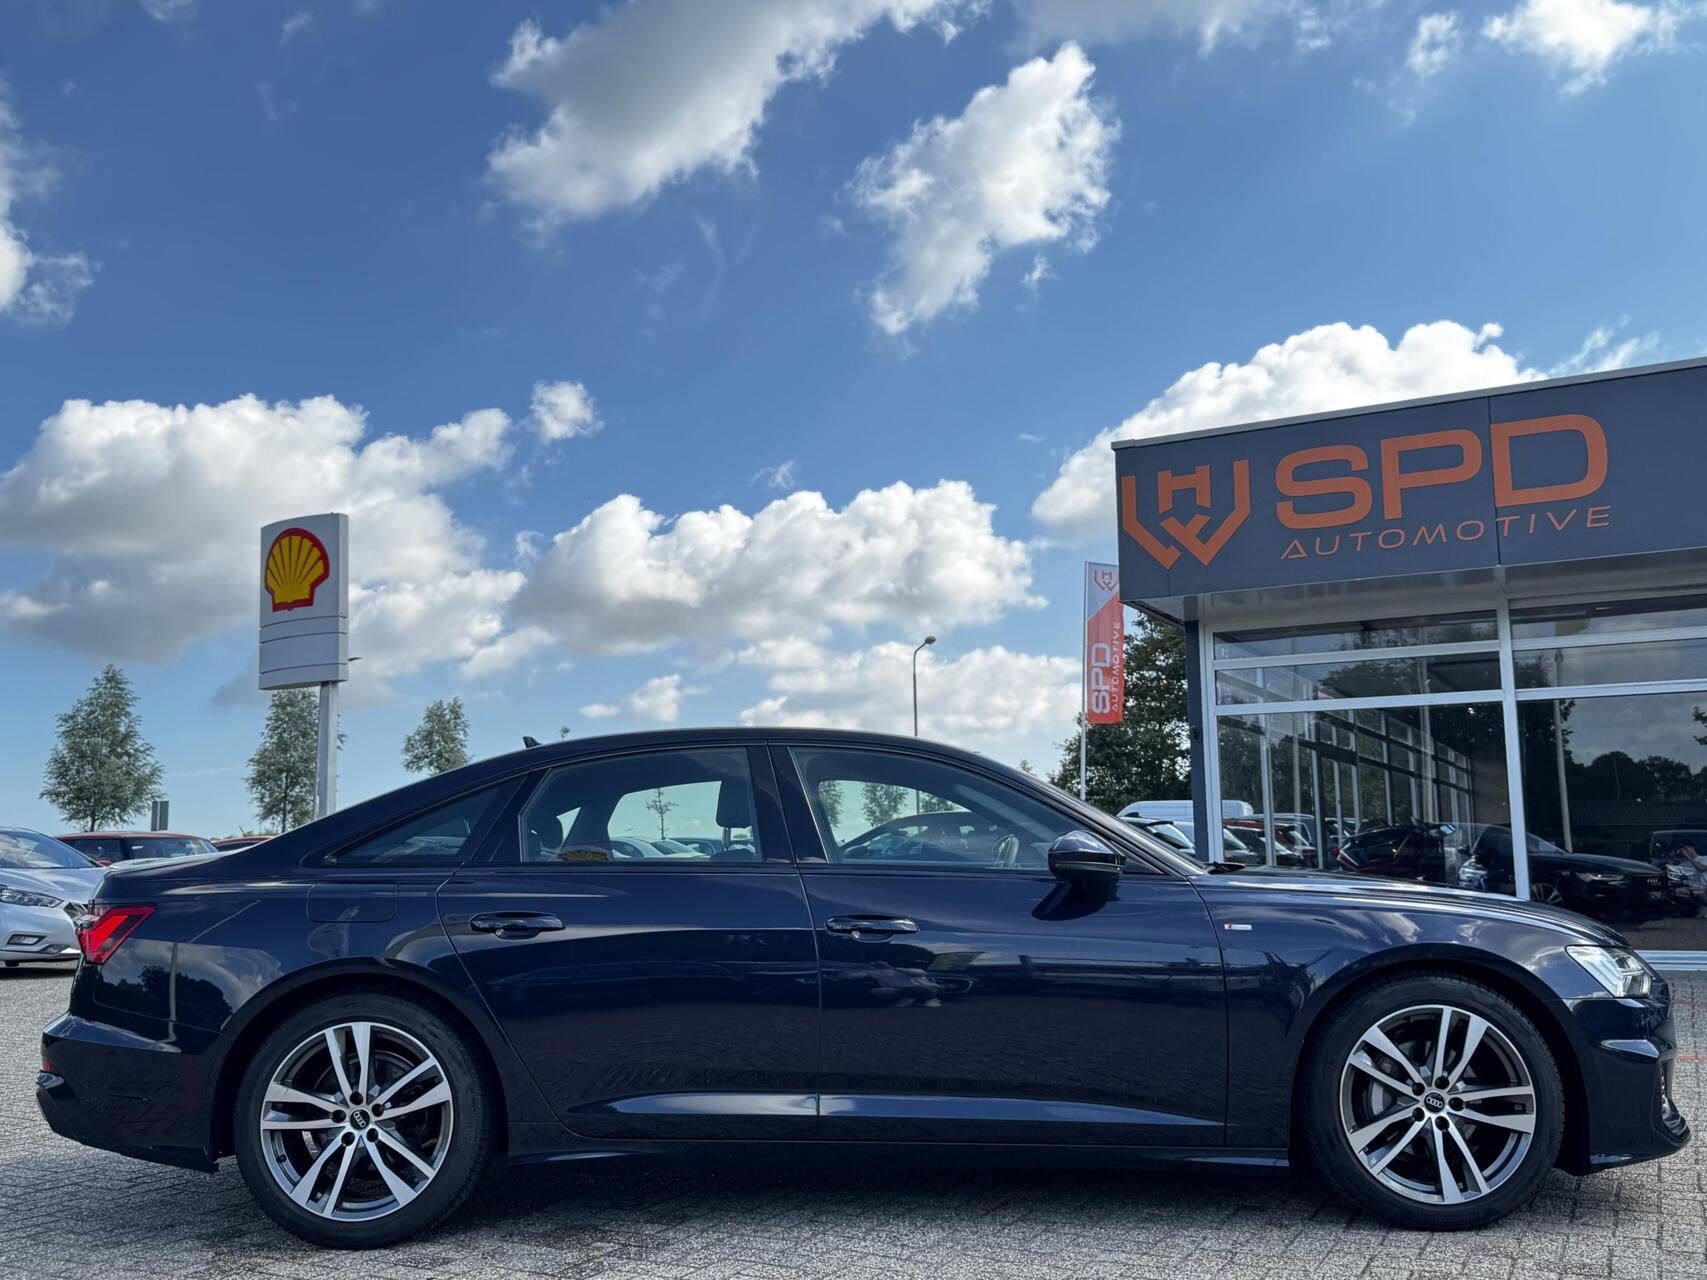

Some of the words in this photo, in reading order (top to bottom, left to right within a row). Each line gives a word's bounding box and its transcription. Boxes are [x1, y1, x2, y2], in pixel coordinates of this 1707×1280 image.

[1275, 414, 1609, 529] SPD
[1280, 505, 1612, 560] AUTOMOTIVE
[1091, 642, 1111, 714] SPD
[1111, 622, 1121, 713] AUTOMOTIVE
